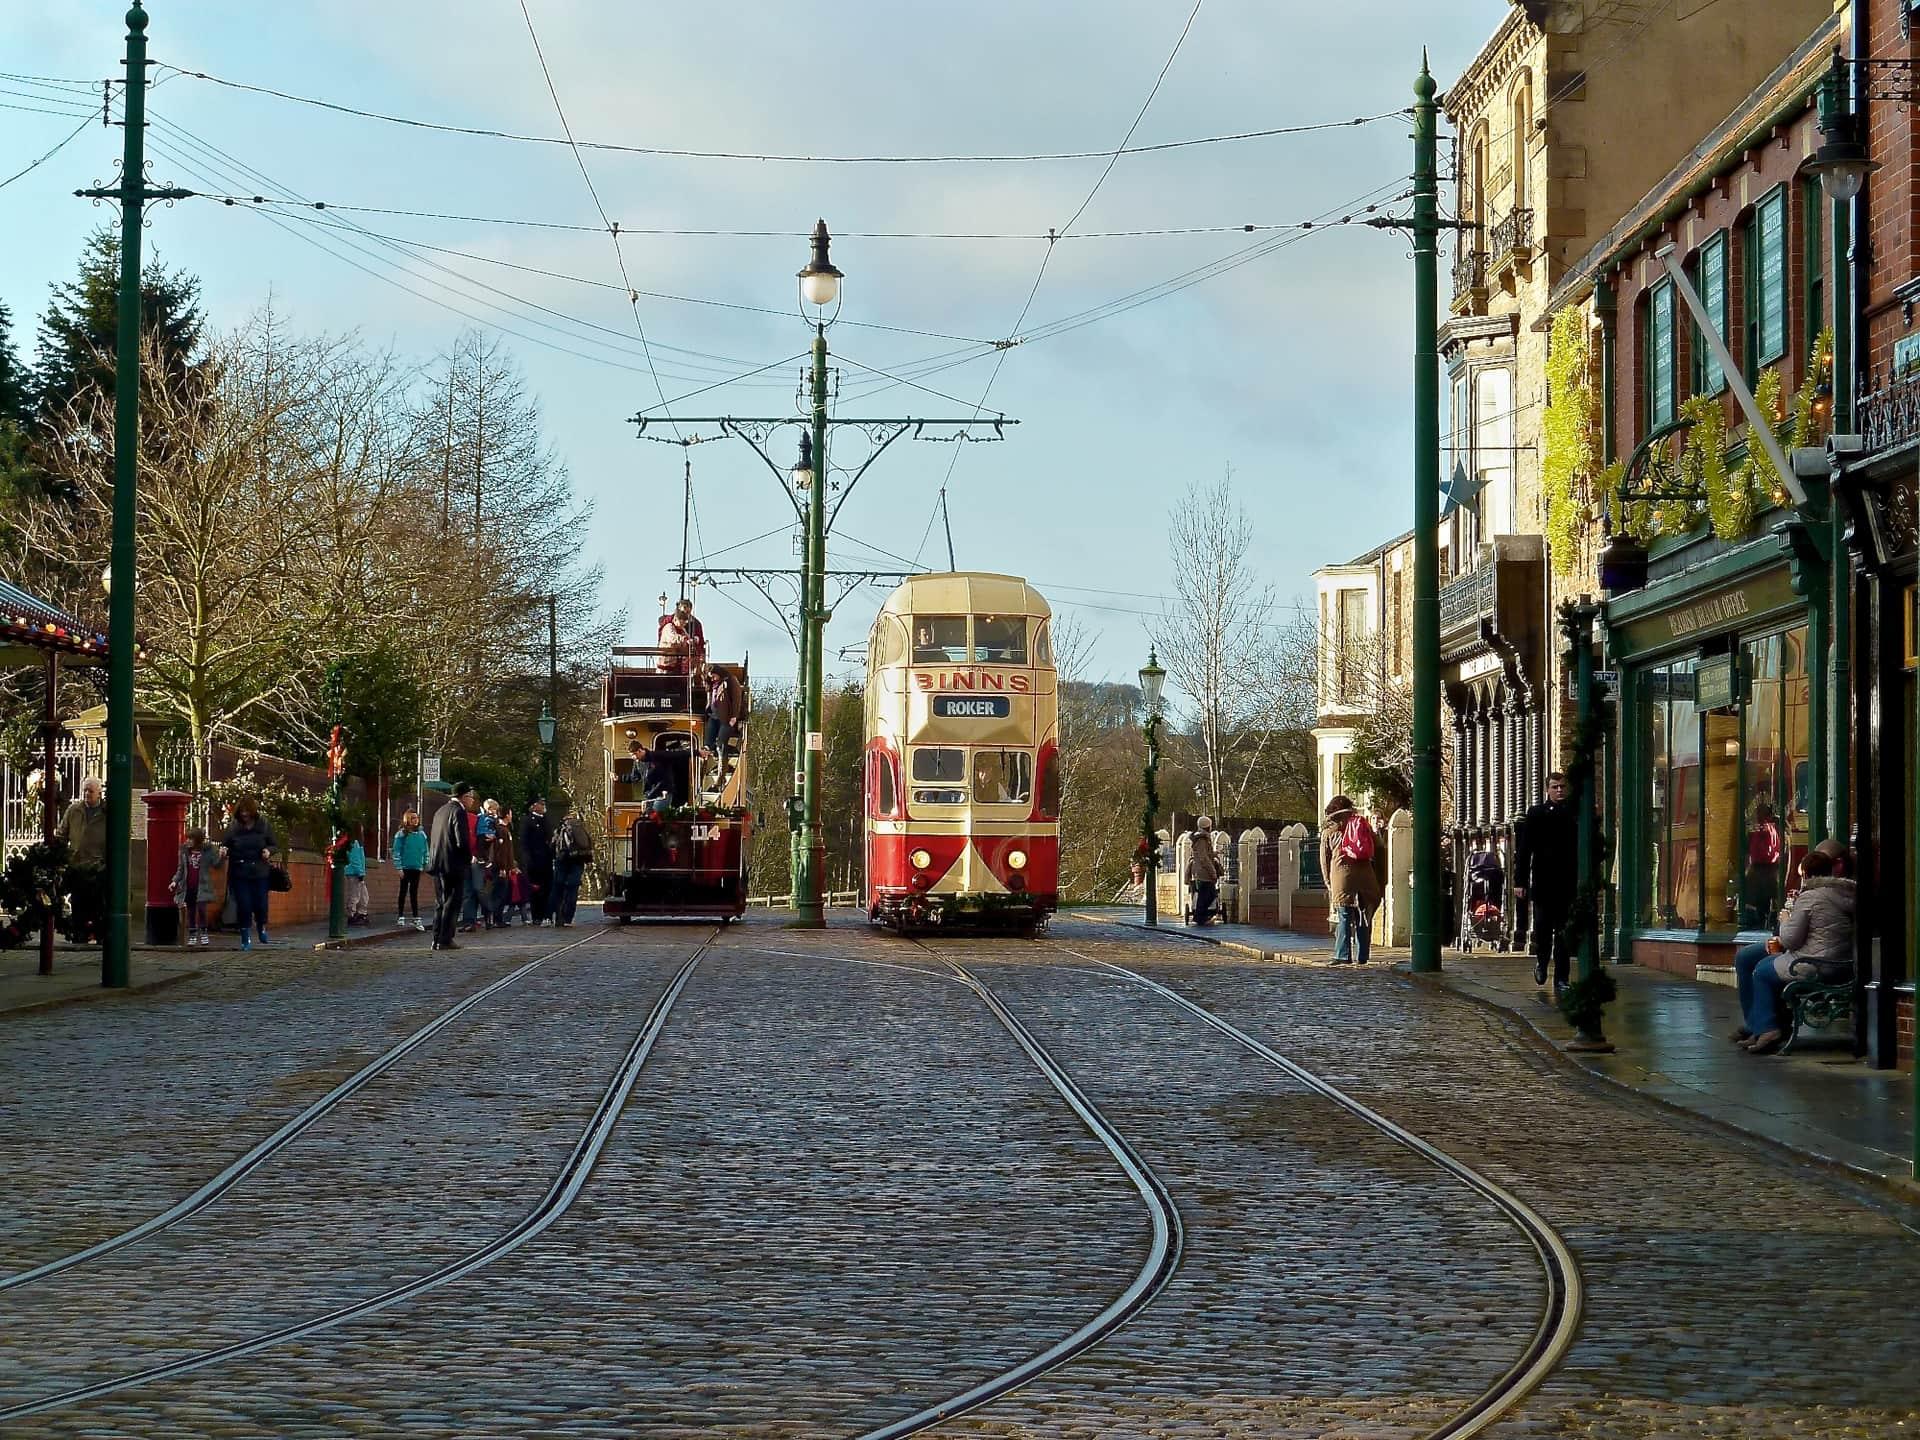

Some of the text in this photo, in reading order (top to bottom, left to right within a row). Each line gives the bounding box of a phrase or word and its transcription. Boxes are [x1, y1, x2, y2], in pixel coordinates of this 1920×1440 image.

[1721, 591, 1749, 618] OFFICE
[914, 672, 1029, 692] BINNS
[624, 698, 655, 708] ELSWICK
[947, 701, 995, 715] ROKER
[691, 825, 721, 841] 114
